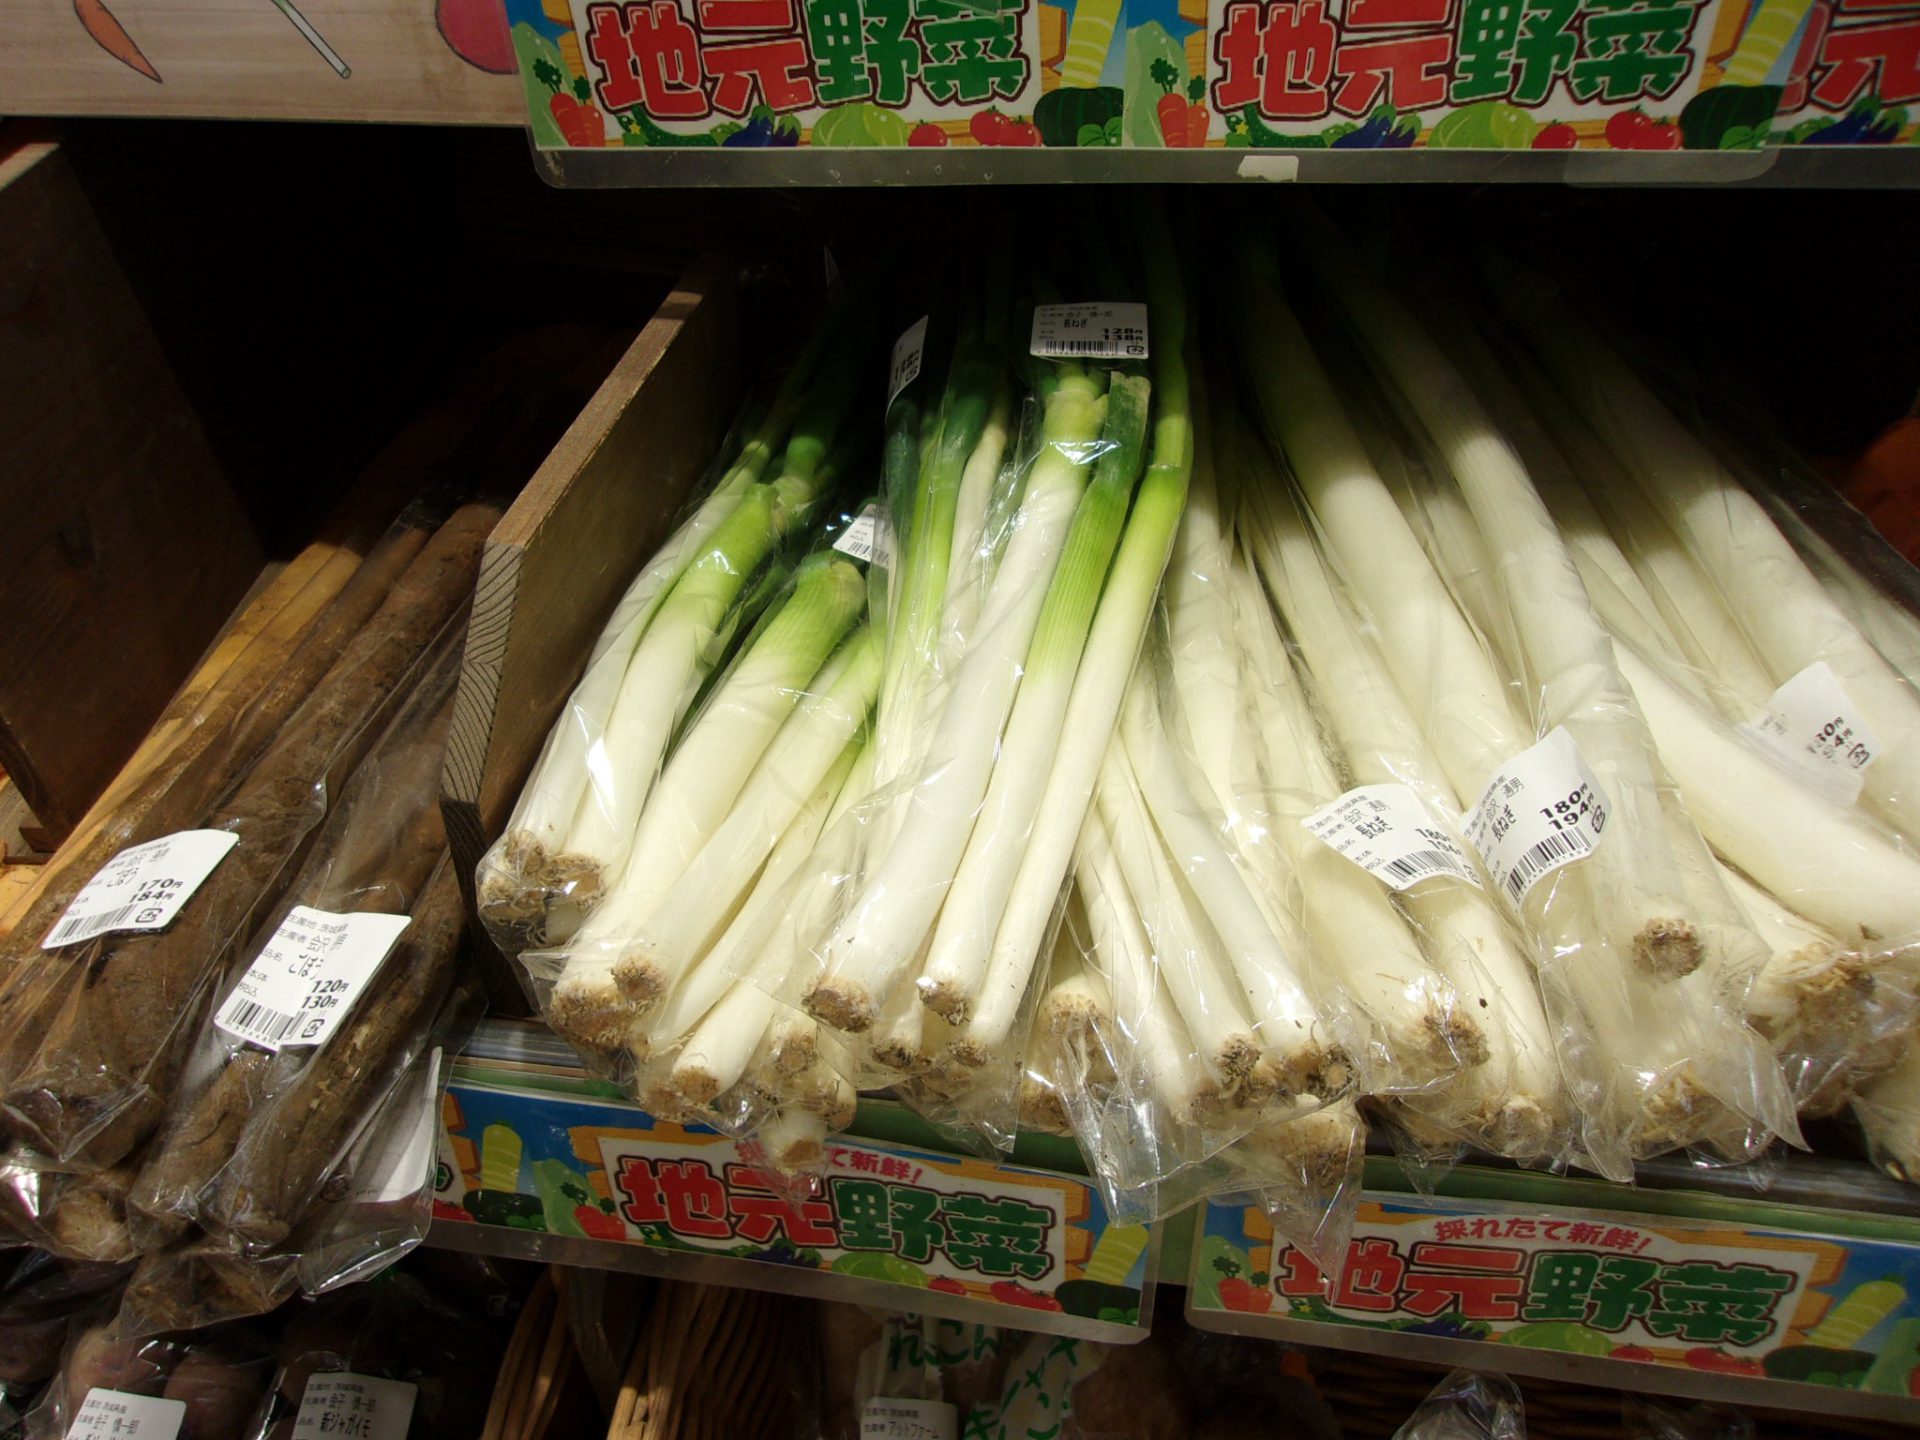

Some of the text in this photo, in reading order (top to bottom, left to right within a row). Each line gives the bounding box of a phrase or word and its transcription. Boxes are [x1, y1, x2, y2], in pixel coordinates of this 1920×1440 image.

[586, 0, 1031, 120] 地元野菜
[1212, 0, 1698, 119] 地元野菜
[1539, 782, 1589, 819] 180円
[1548, 792, 1596, 831] 194円
[1354, 814, 1394, 840] 長ねぎ
[1490, 803, 1518, 844] 長ねぎ
[128, 889, 175, 904] 184円
[137, 877, 184, 893] 170円
[301, 995, 340, 1009] 130円
[311, 978, 350, 994] 120円
[613, 1154, 1059, 1282] 地元野菜
[1434, 1217, 1653, 1255] 採れたて新鮮!
[1273, 1237, 1800, 1349] 地元野菜
